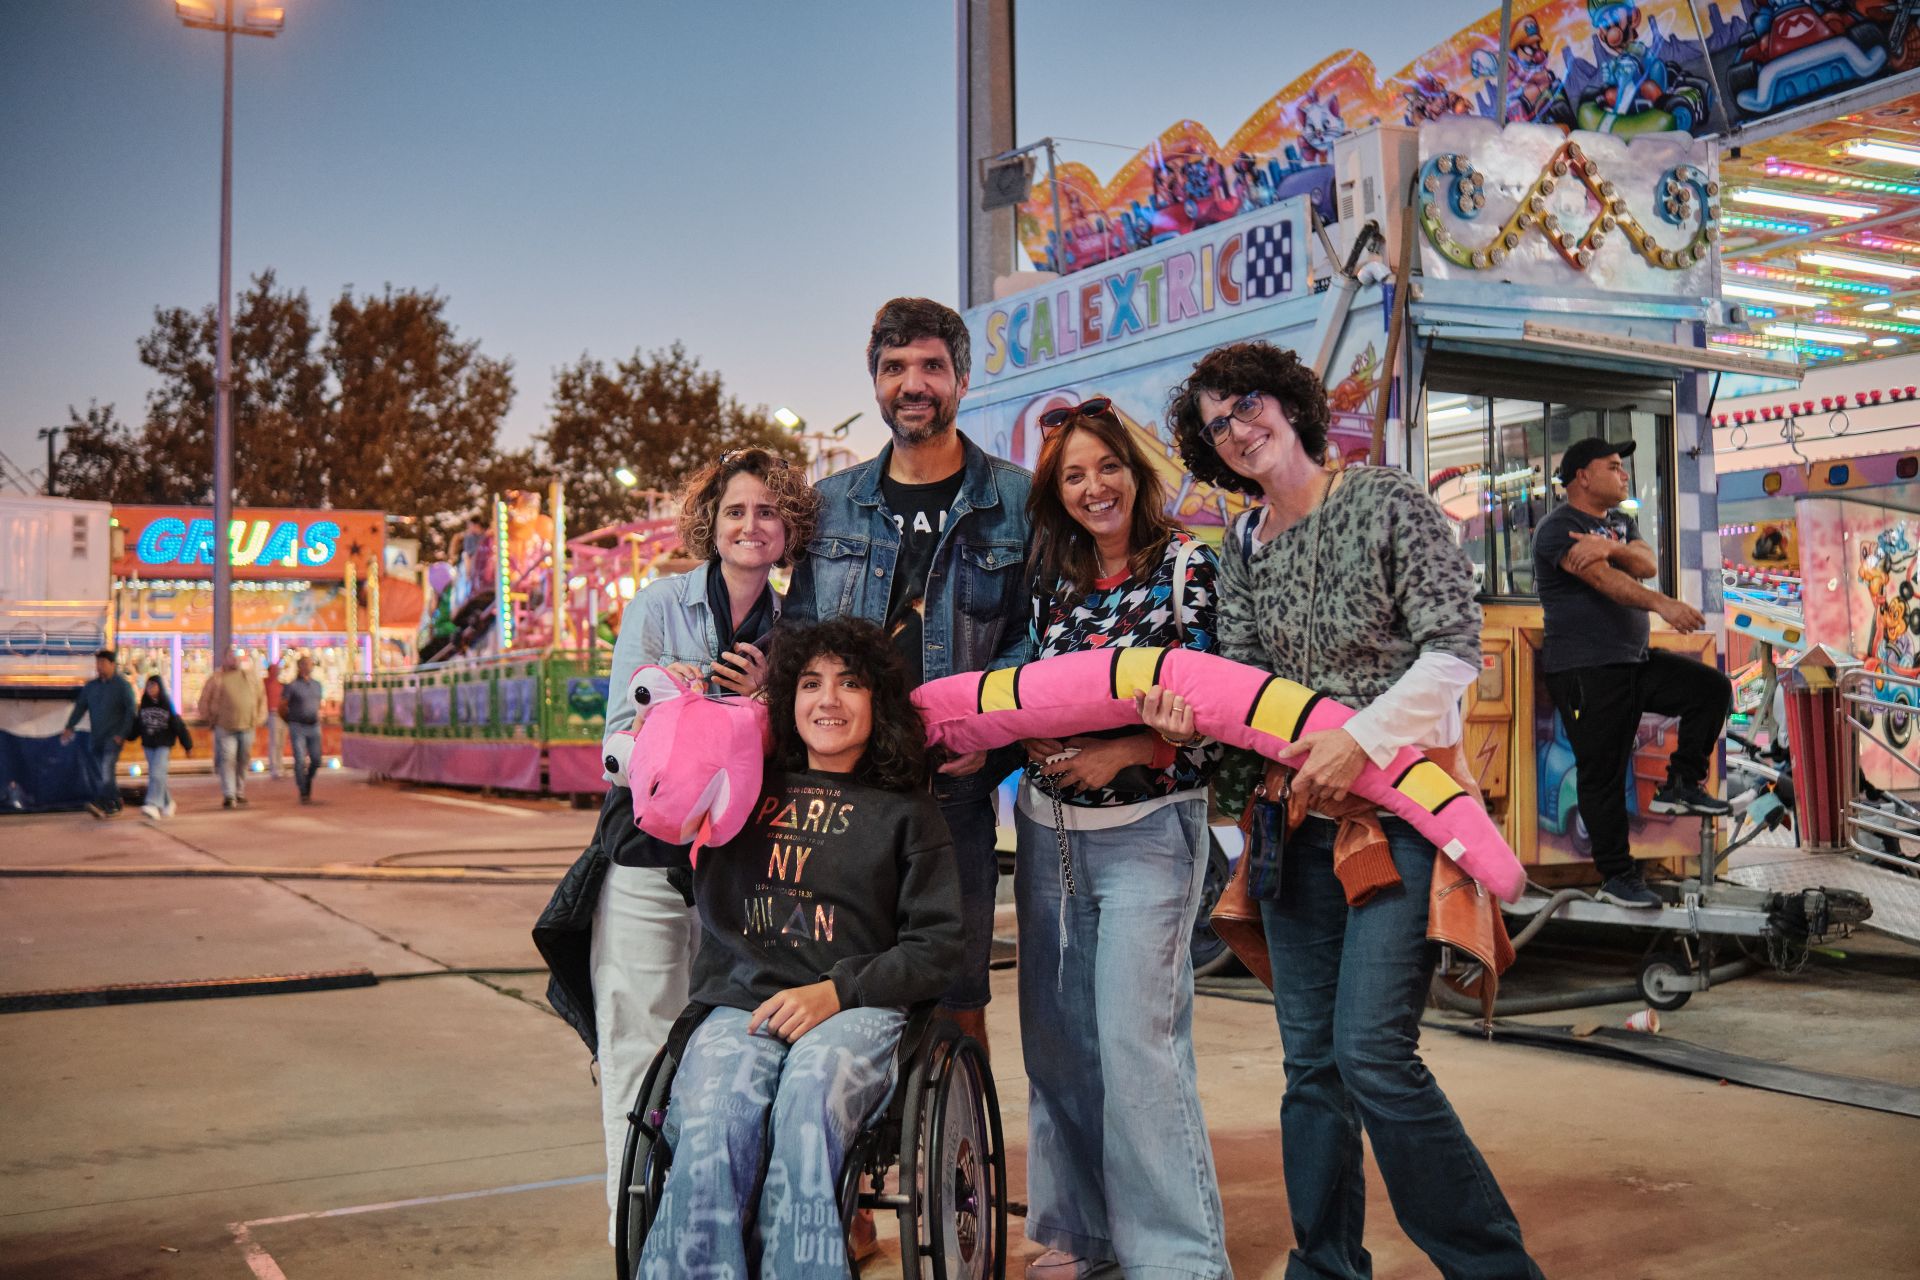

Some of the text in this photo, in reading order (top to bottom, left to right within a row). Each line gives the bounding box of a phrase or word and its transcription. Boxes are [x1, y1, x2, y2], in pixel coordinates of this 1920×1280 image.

[985, 232, 1242, 375] SCALEXTRIC
[136, 517, 341, 567] GRUAS
[801, 787, 825, 796] LONDON
[755, 796, 854, 834] PARIS
[768, 842, 812, 884] NY
